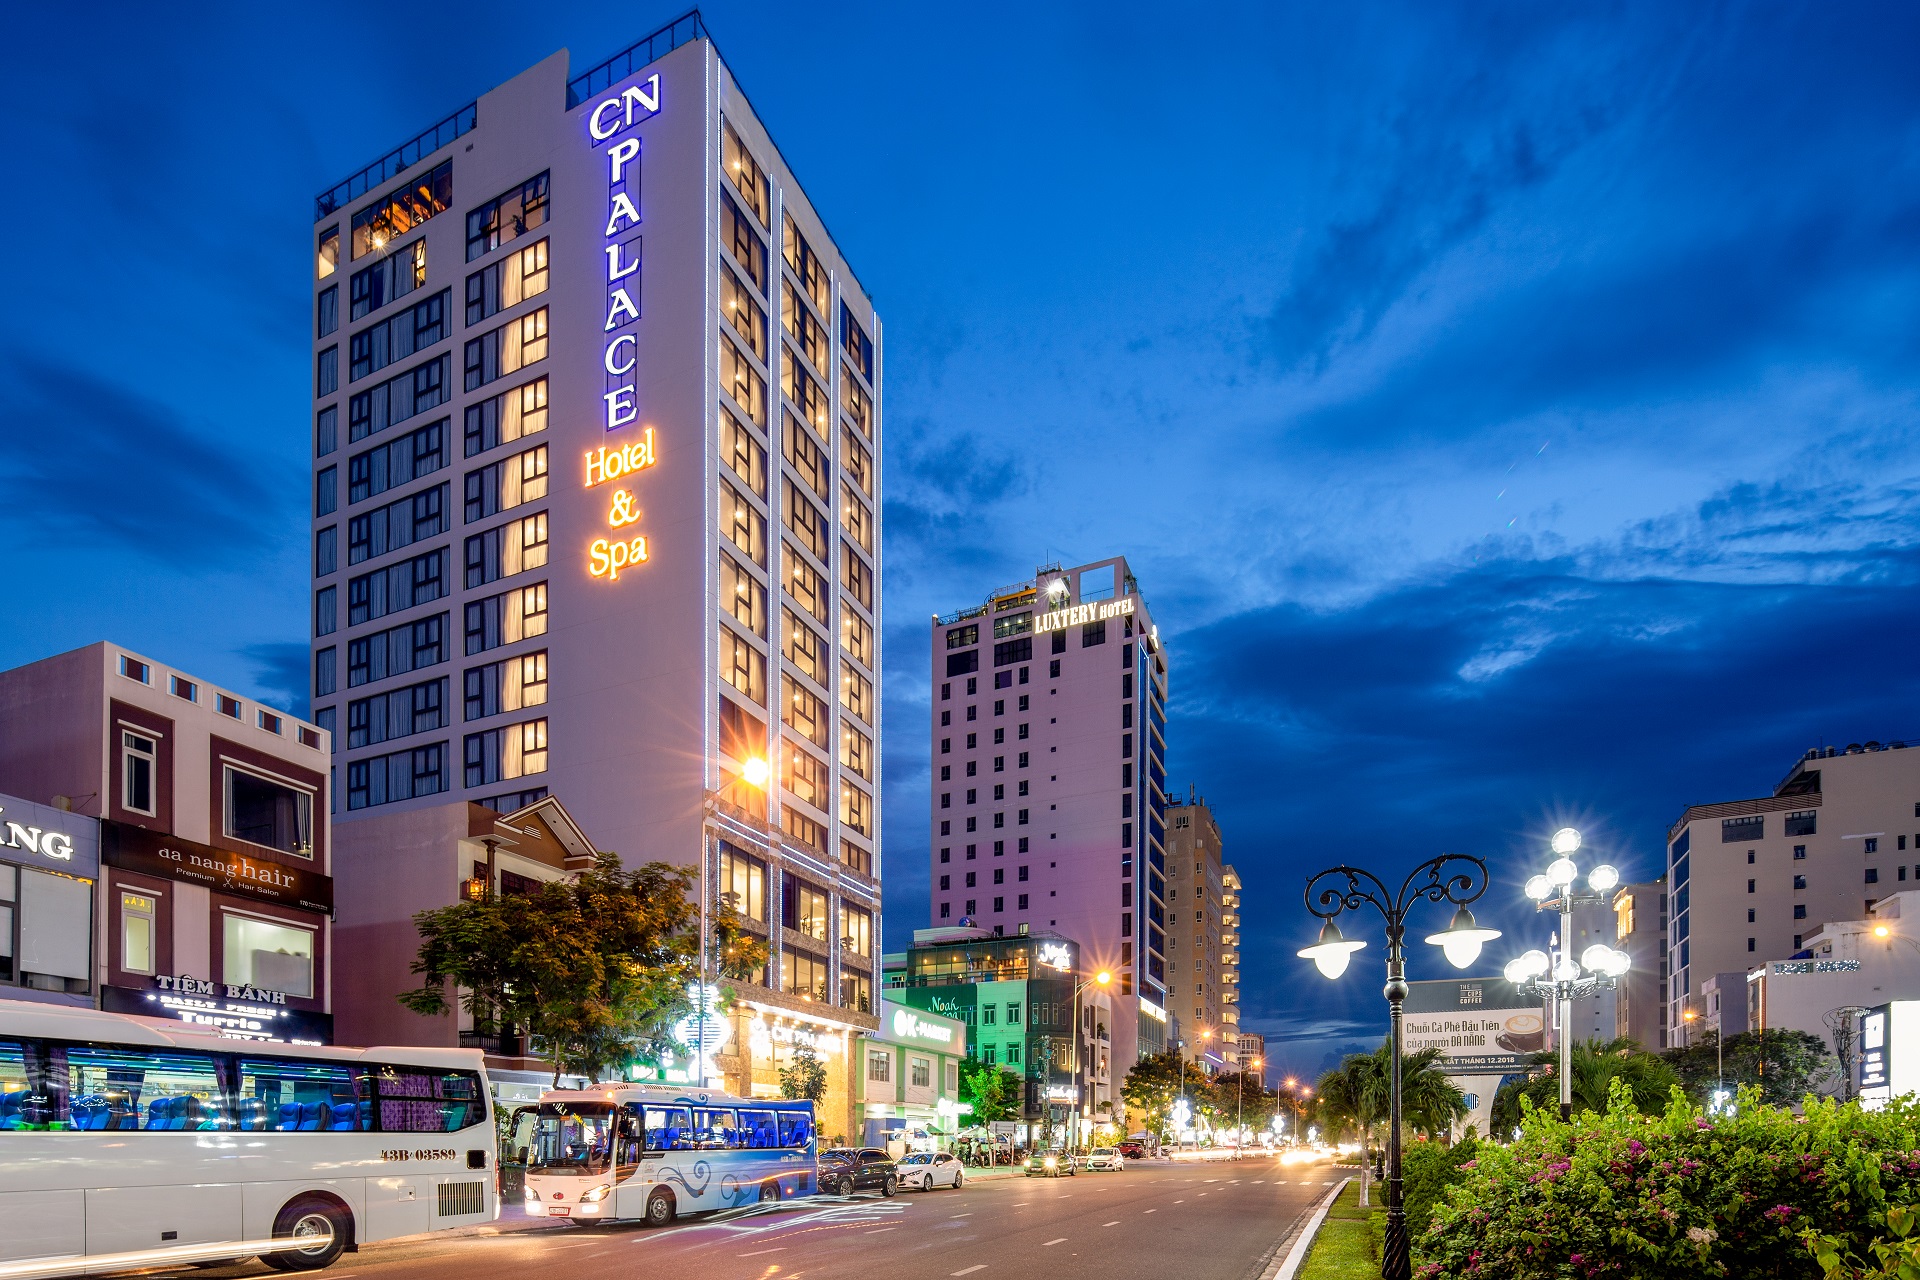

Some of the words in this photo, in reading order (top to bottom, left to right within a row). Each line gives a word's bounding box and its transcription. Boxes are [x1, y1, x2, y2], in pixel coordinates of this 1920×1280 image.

[590, 73, 660, 140] CN
[604, 137, 641, 431] PALACE
[584, 427, 656, 488] Hotel
[608, 489, 642, 528] &
[589, 537, 650, 580] Spa
[1034, 602, 1098, 634] LUXTERY
[1099, 598, 1135, 619] HOTEL
[158, 847, 183, 862] da
[189, 854, 238, 878] nang
[240, 857, 295, 888] hair
[175, 867, 215, 882] Premium
[238, 881, 255, 891] Hair
[256, 886, 280, 897] Salon
[157, 973, 214, 995] TIỆM
[928, 996, 959, 1012] Noah
[1431, 1021, 1443, 1033] Cà
[1444, 1021, 1460, 1033] Phê
[1480, 1019, 1500, 1031] Tiên
[1461, 1056, 1486, 1065] THÁNG
[1487, 1056, 1515, 1064] 12.2018
